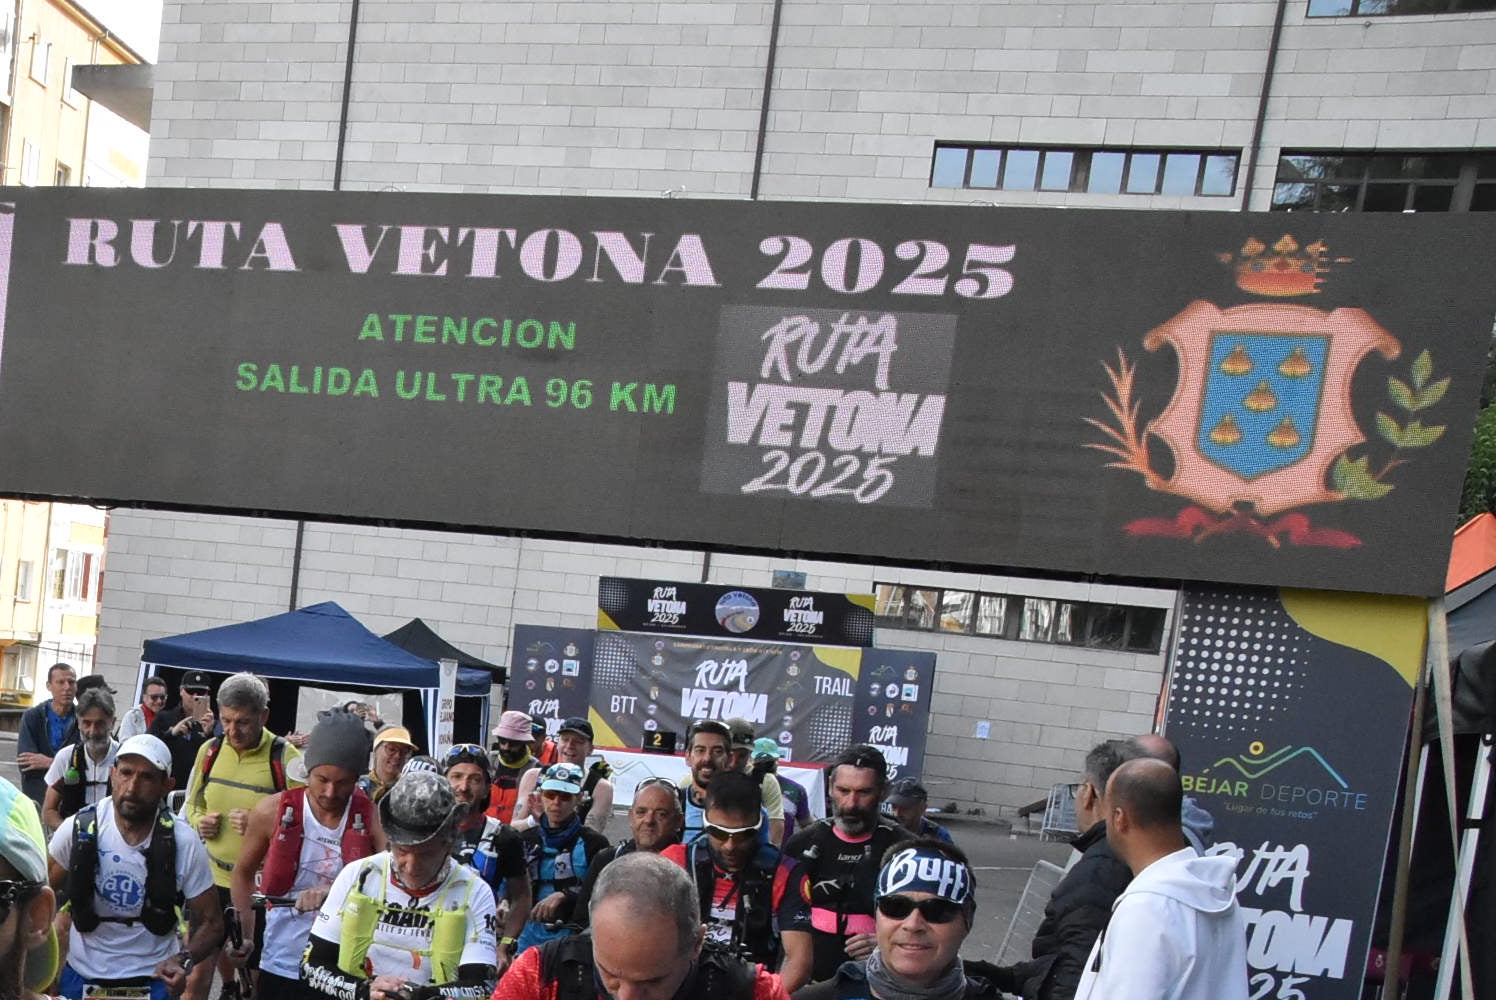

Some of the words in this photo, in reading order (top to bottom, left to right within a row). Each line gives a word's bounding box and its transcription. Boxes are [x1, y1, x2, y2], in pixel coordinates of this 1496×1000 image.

[61, 216, 301, 273] RUTA
[331, 224, 720, 287] VETONA
[756, 236, 1018, 299] 2025
[358, 313, 577, 350] ATENCION
[760, 312, 898, 390] RUTA
[236, 362, 379, 398] SALIDA
[395, 370, 533, 406] ULTRA
[545, 378, 594, 409] 96
[609, 382, 677, 414] KM
[727, 381, 947, 456] VETONA
[741, 450, 898, 503] 2025
[694, 658, 747, 692] RUTA
[813, 675, 854, 697] TRAIL
[610, 695, 638, 714] BTT
[653, 733, 663, 746] 2
[1261, 783, 1369, 811] DEPORTE
